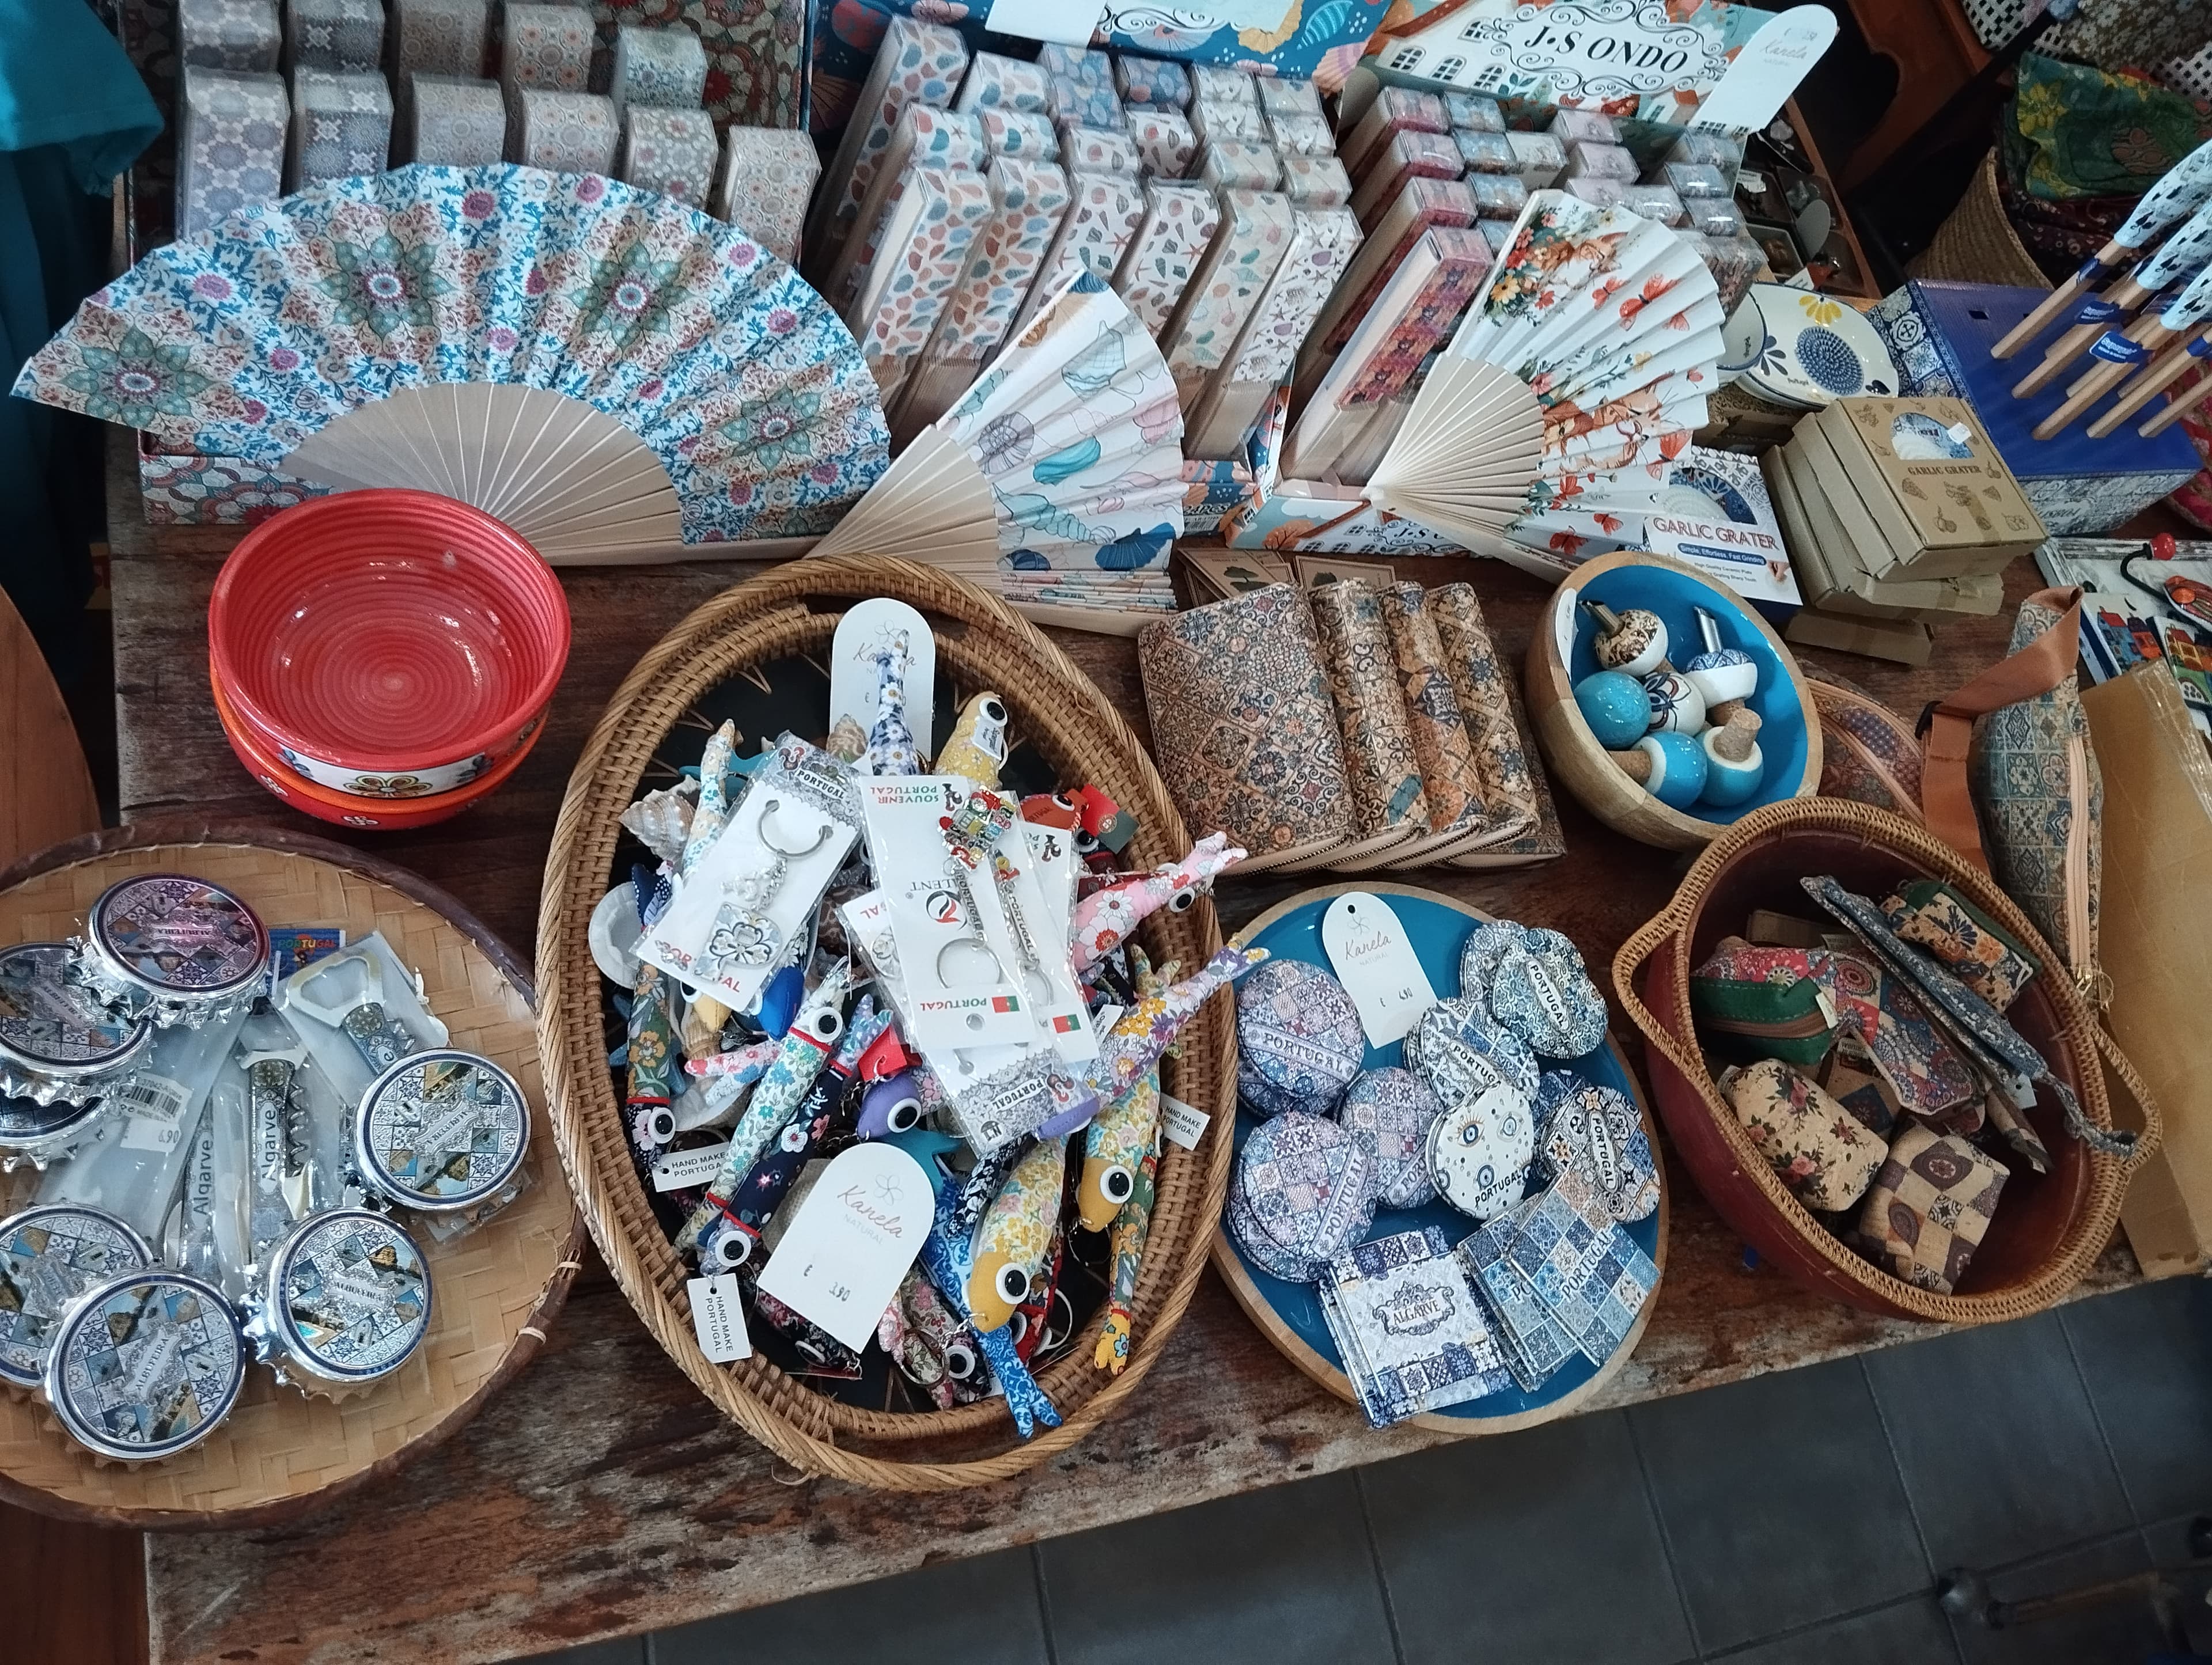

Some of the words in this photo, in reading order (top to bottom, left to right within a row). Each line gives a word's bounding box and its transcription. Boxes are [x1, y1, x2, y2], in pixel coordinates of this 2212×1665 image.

[1587, 36, 1689, 74] ONDO
[1907, 466, 1944, 475] GARLIC
[1944, 465, 1982, 475] GRATER
[1653, 517, 1714, 540] GARLIC
[1715, 526, 1780, 551] GRATER
[1728, 551, 1741, 560] Fast
[1741, 553, 1765, 565] Grinding
[797, 770, 845, 799] PORTUGAL
[870, 786, 937, 795] PORTUGAL
[878, 795, 939, 804] SOUVENIR
[278, 939, 337, 949] PORTUGAL
[1346, 930, 1392, 961] Kanela
[919, 998, 987, 1012] PORTUGAL
[1530, 964, 1563, 1027] PORTUGAL
[1263, 1032, 1343, 1074] PORTUGAL
[992, 1079, 1043, 1110] PORTUGAL
[1163, 1114, 1195, 1138] PORTUGAL
[1165, 1106, 1181, 1118] HAND
[1180, 1114, 1201, 1129] MAKE
[260, 1109, 280, 1182] Algarve
[671, 1158, 698, 1169] HAND
[700, 1151, 726, 1163] MAKE
[1592, 1118, 1613, 1185] PORTUGAL
[193, 1139, 214, 1216] Algarve
[673, 1162, 721, 1177] PORTUGA
[1325, 1159, 1365, 1239] PORTUGAL
[1475, 1170, 1522, 1207] PORTUGAL
[837, 1184, 903, 1238] Kanela
[843, 1213, 884, 1245] NATURAL
[1562, 1231, 1610, 1300] PORTUGAL
[715, 1296, 728, 1322] HAND
[1393, 1300, 1441, 1325] ALGARVE
[705, 1297, 722, 1353] PORTUGAL
[721, 1325, 733, 1352] MAKE
[135, 1337, 169, 1390] ALBUFEIRA
